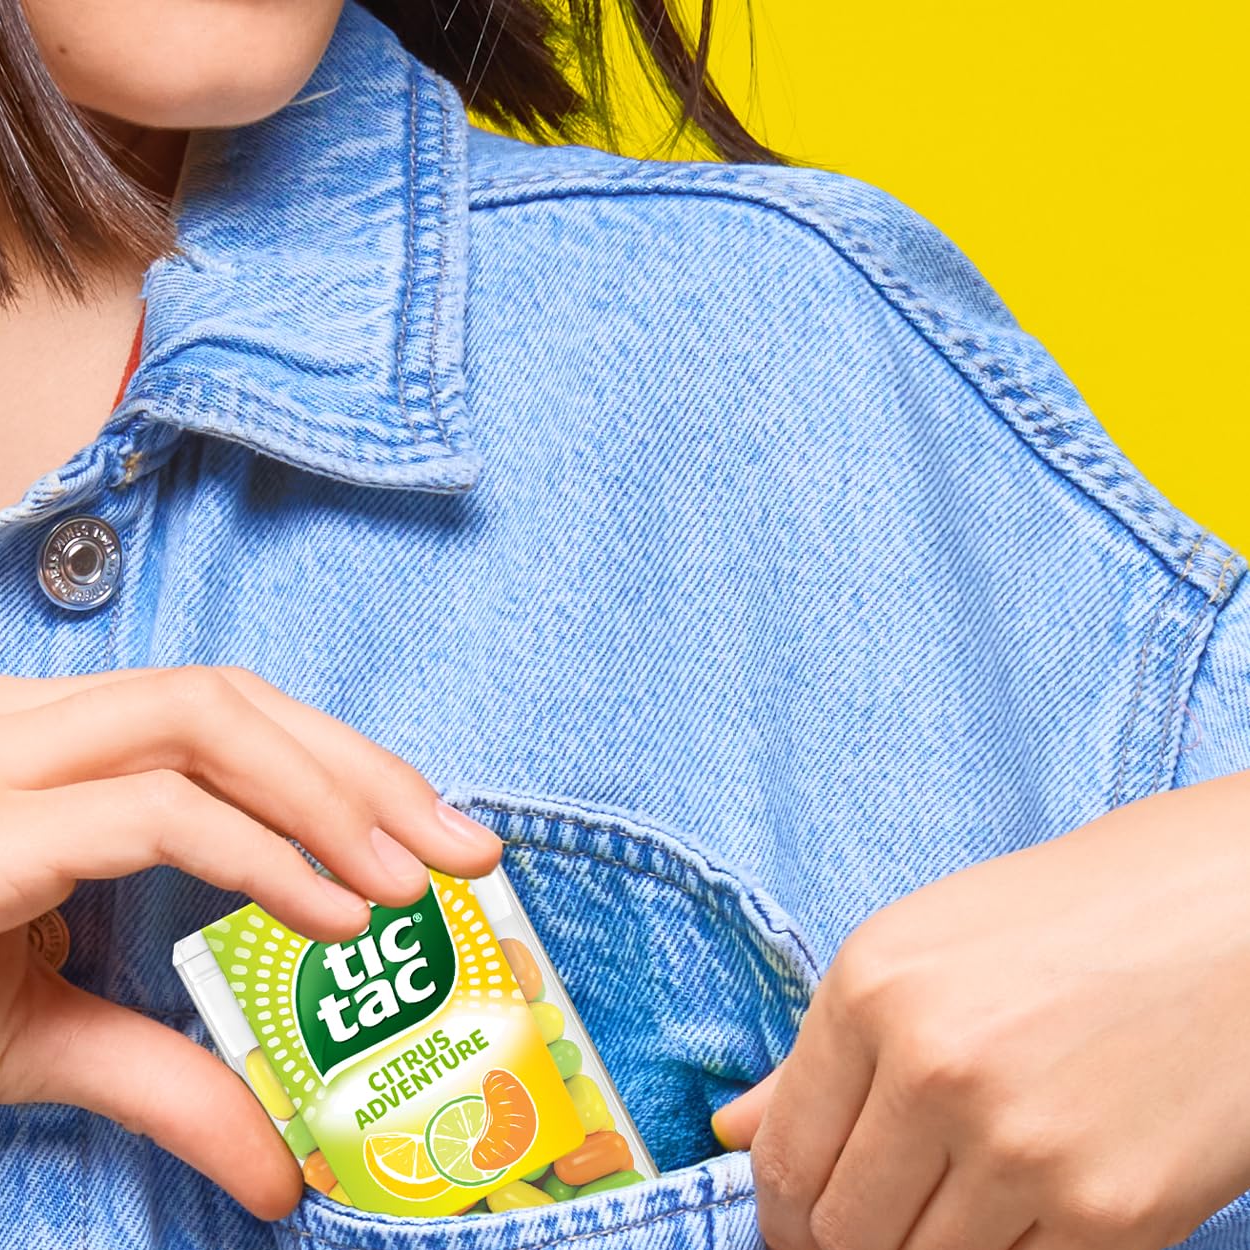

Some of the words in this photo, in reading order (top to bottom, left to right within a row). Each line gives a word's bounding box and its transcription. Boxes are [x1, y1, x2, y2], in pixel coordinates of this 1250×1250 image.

[317, 957, 436, 1042] tac
[354, 1029, 489, 1130] ADVENTURE
[368, 1029, 451, 1092] CITRUS
